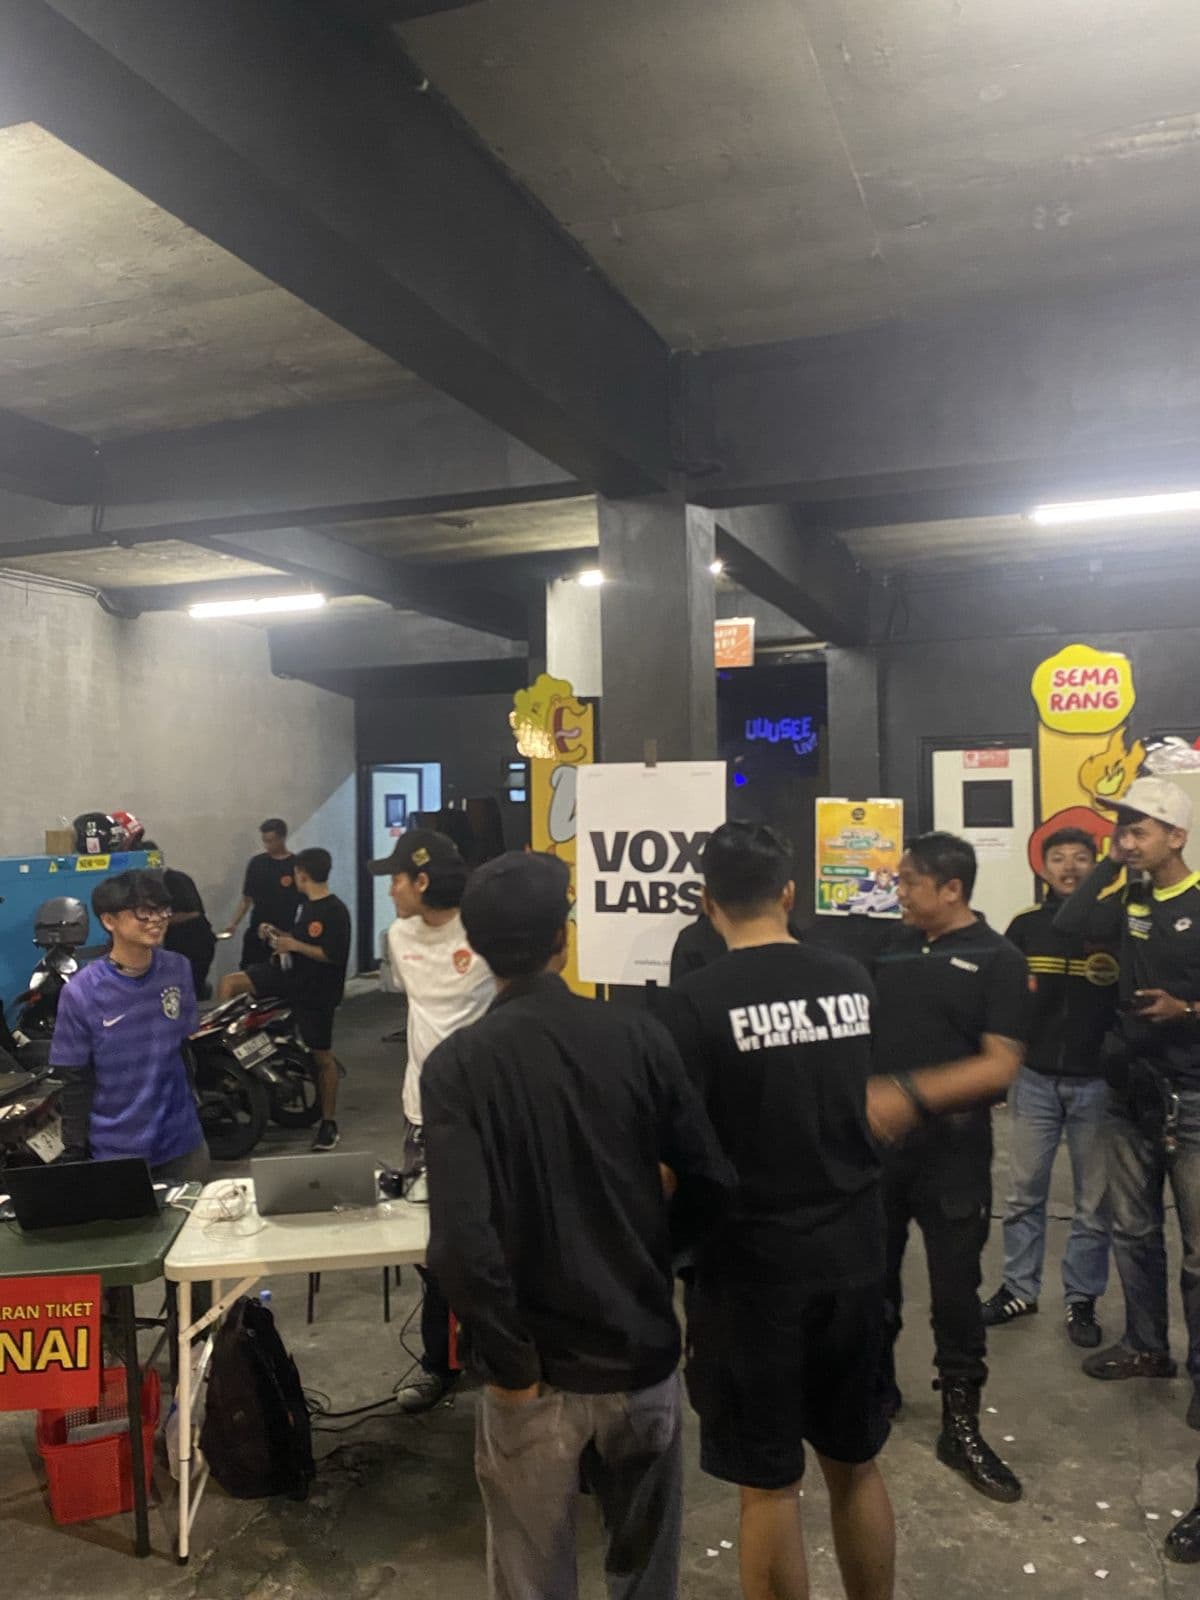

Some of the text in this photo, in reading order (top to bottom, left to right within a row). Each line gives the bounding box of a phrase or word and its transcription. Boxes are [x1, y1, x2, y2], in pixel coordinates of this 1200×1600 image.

[1053, 667, 1119, 688] SEMA
[1050, 691, 1119, 711] RANG
[589, 830, 711, 874] VOX
[595, 880, 706, 916] LABS
[728, 993, 870, 1040] FUCK YOU
[737, 1034, 761, 1052] WE
[763, 1030, 790, 1047] ARE
[791, 1025, 829, 1045] FROM
[0, 1302, 93, 1320] RAN TIKET
[0, 1327, 89, 1373] NAI
